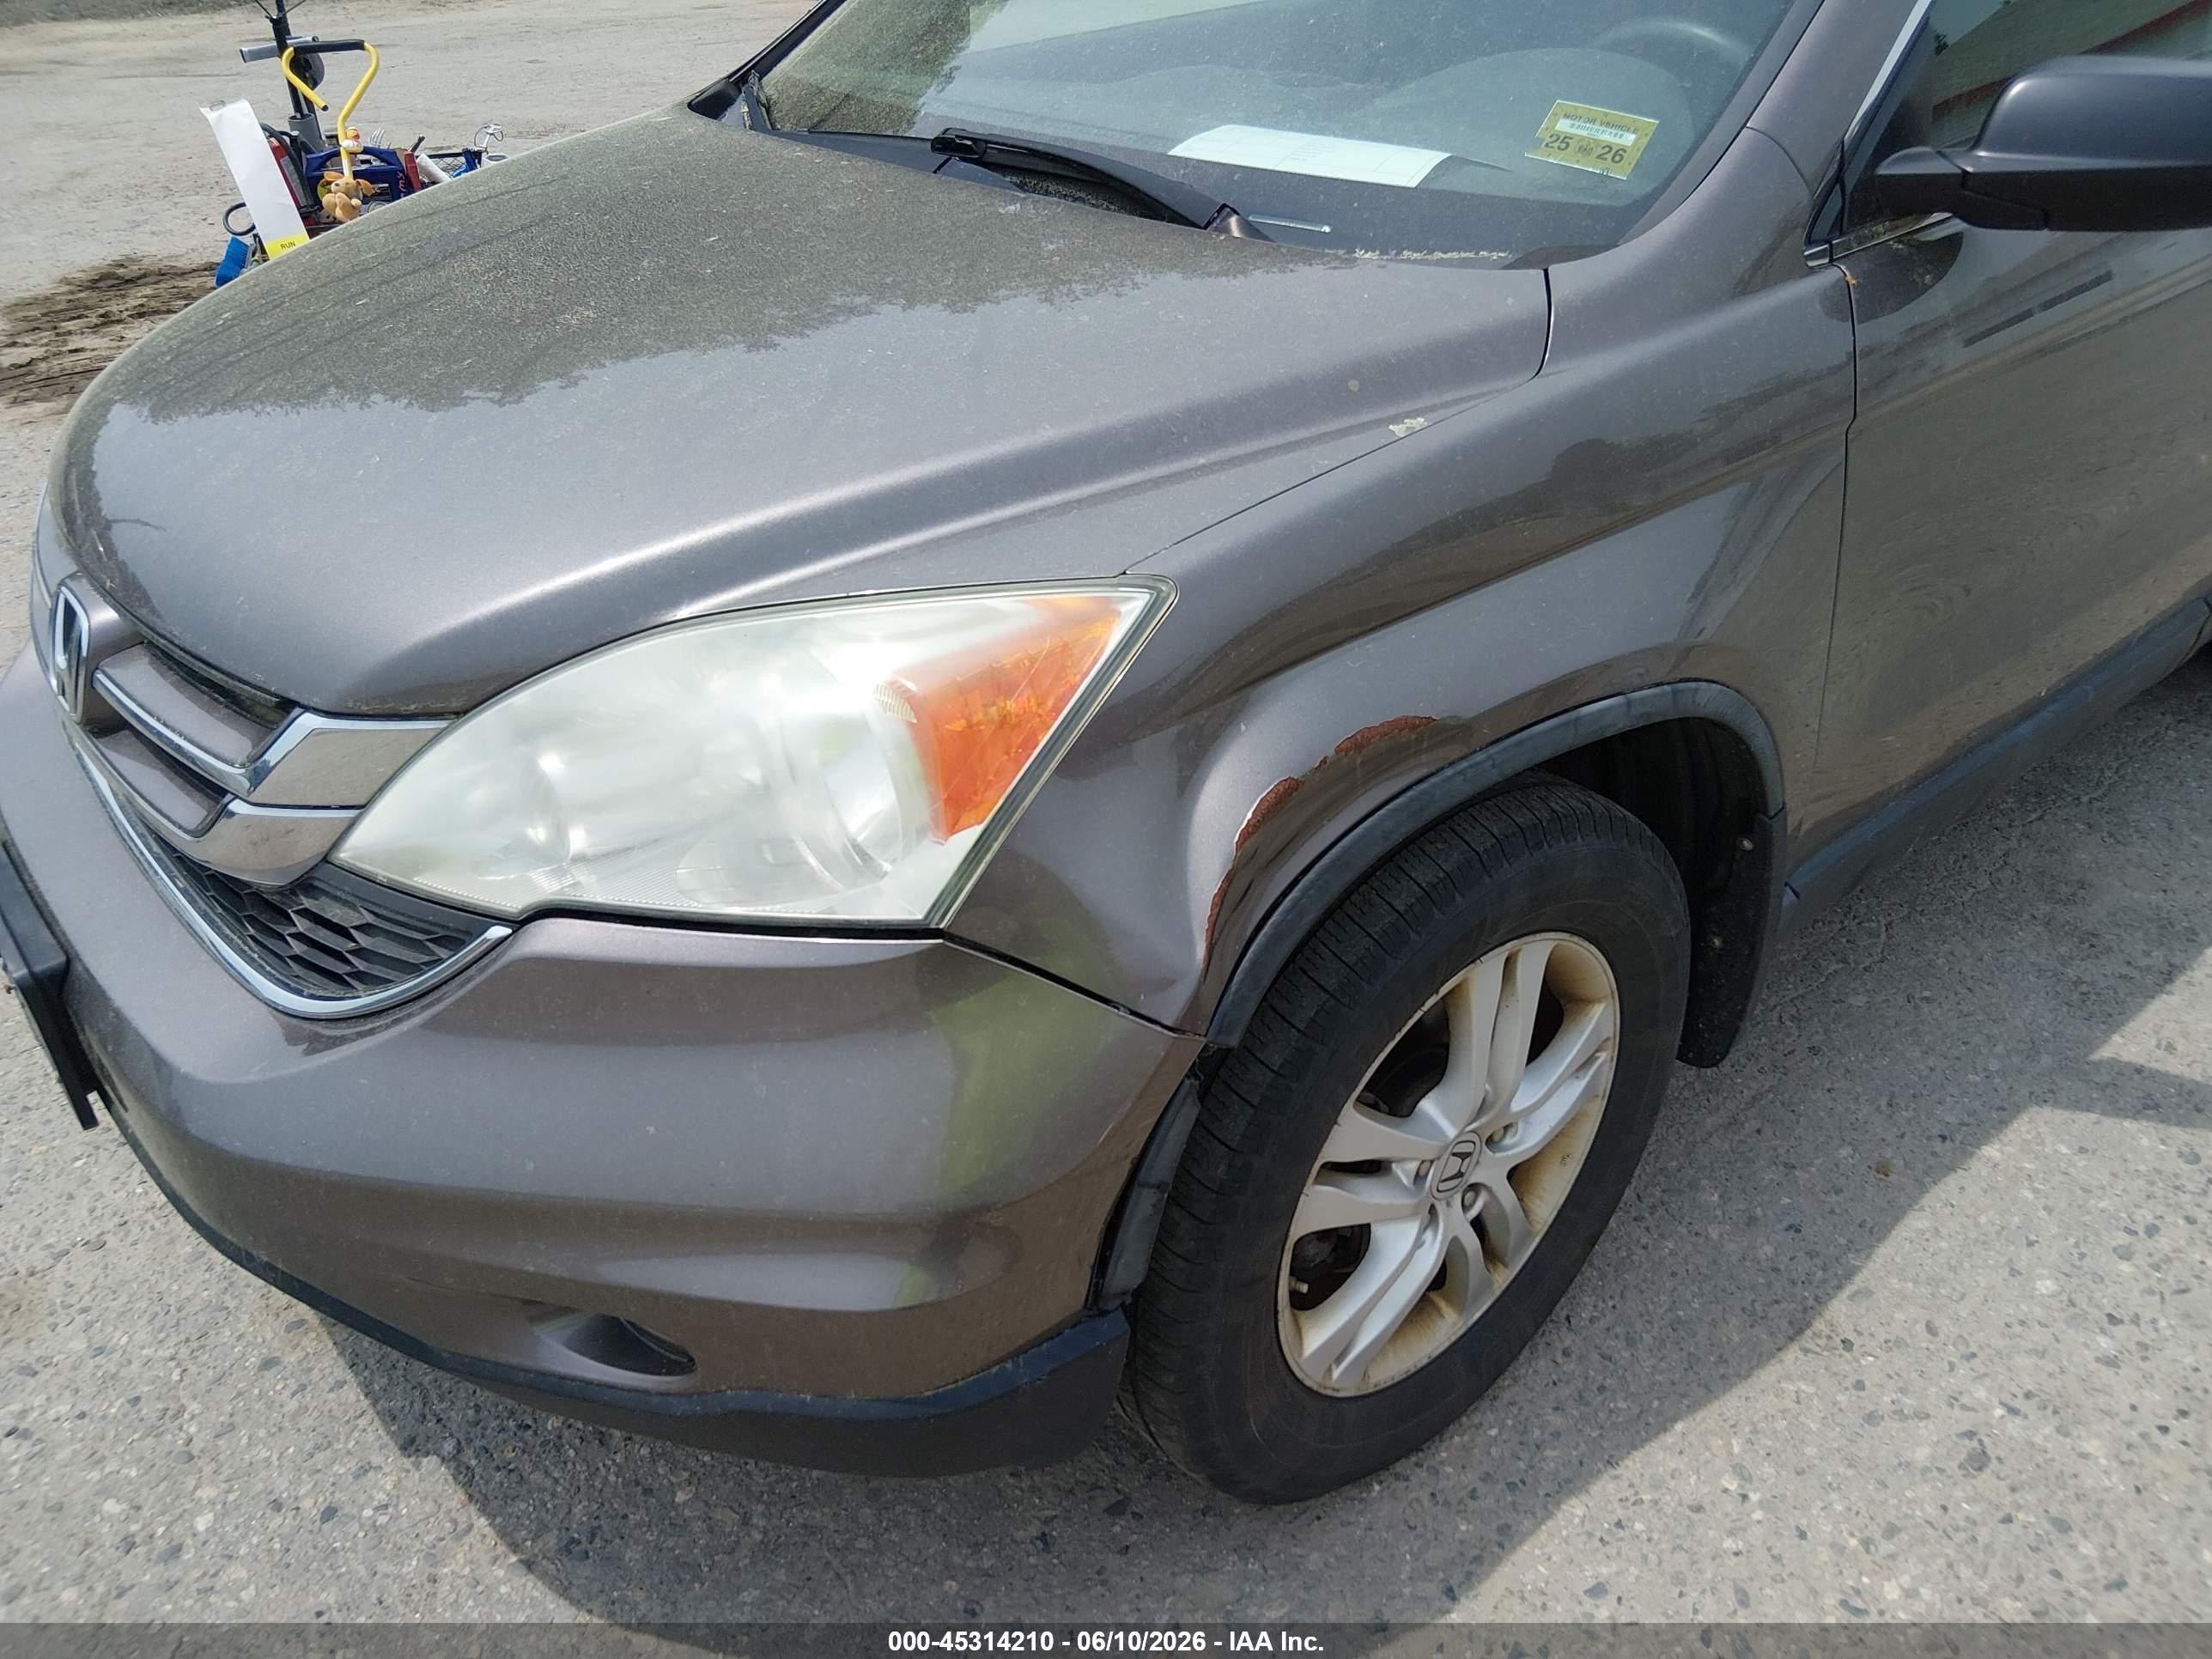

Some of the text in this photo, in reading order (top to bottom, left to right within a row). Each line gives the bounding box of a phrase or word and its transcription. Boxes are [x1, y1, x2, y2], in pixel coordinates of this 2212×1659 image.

[1563, 112, 1596, 125] MOTOR
[1600, 120, 1639, 135] VEHICLE
[1546, 133, 1573, 151] 25
[1595, 144, 1626, 164] 26
[280, 240, 296, 250] RUN
